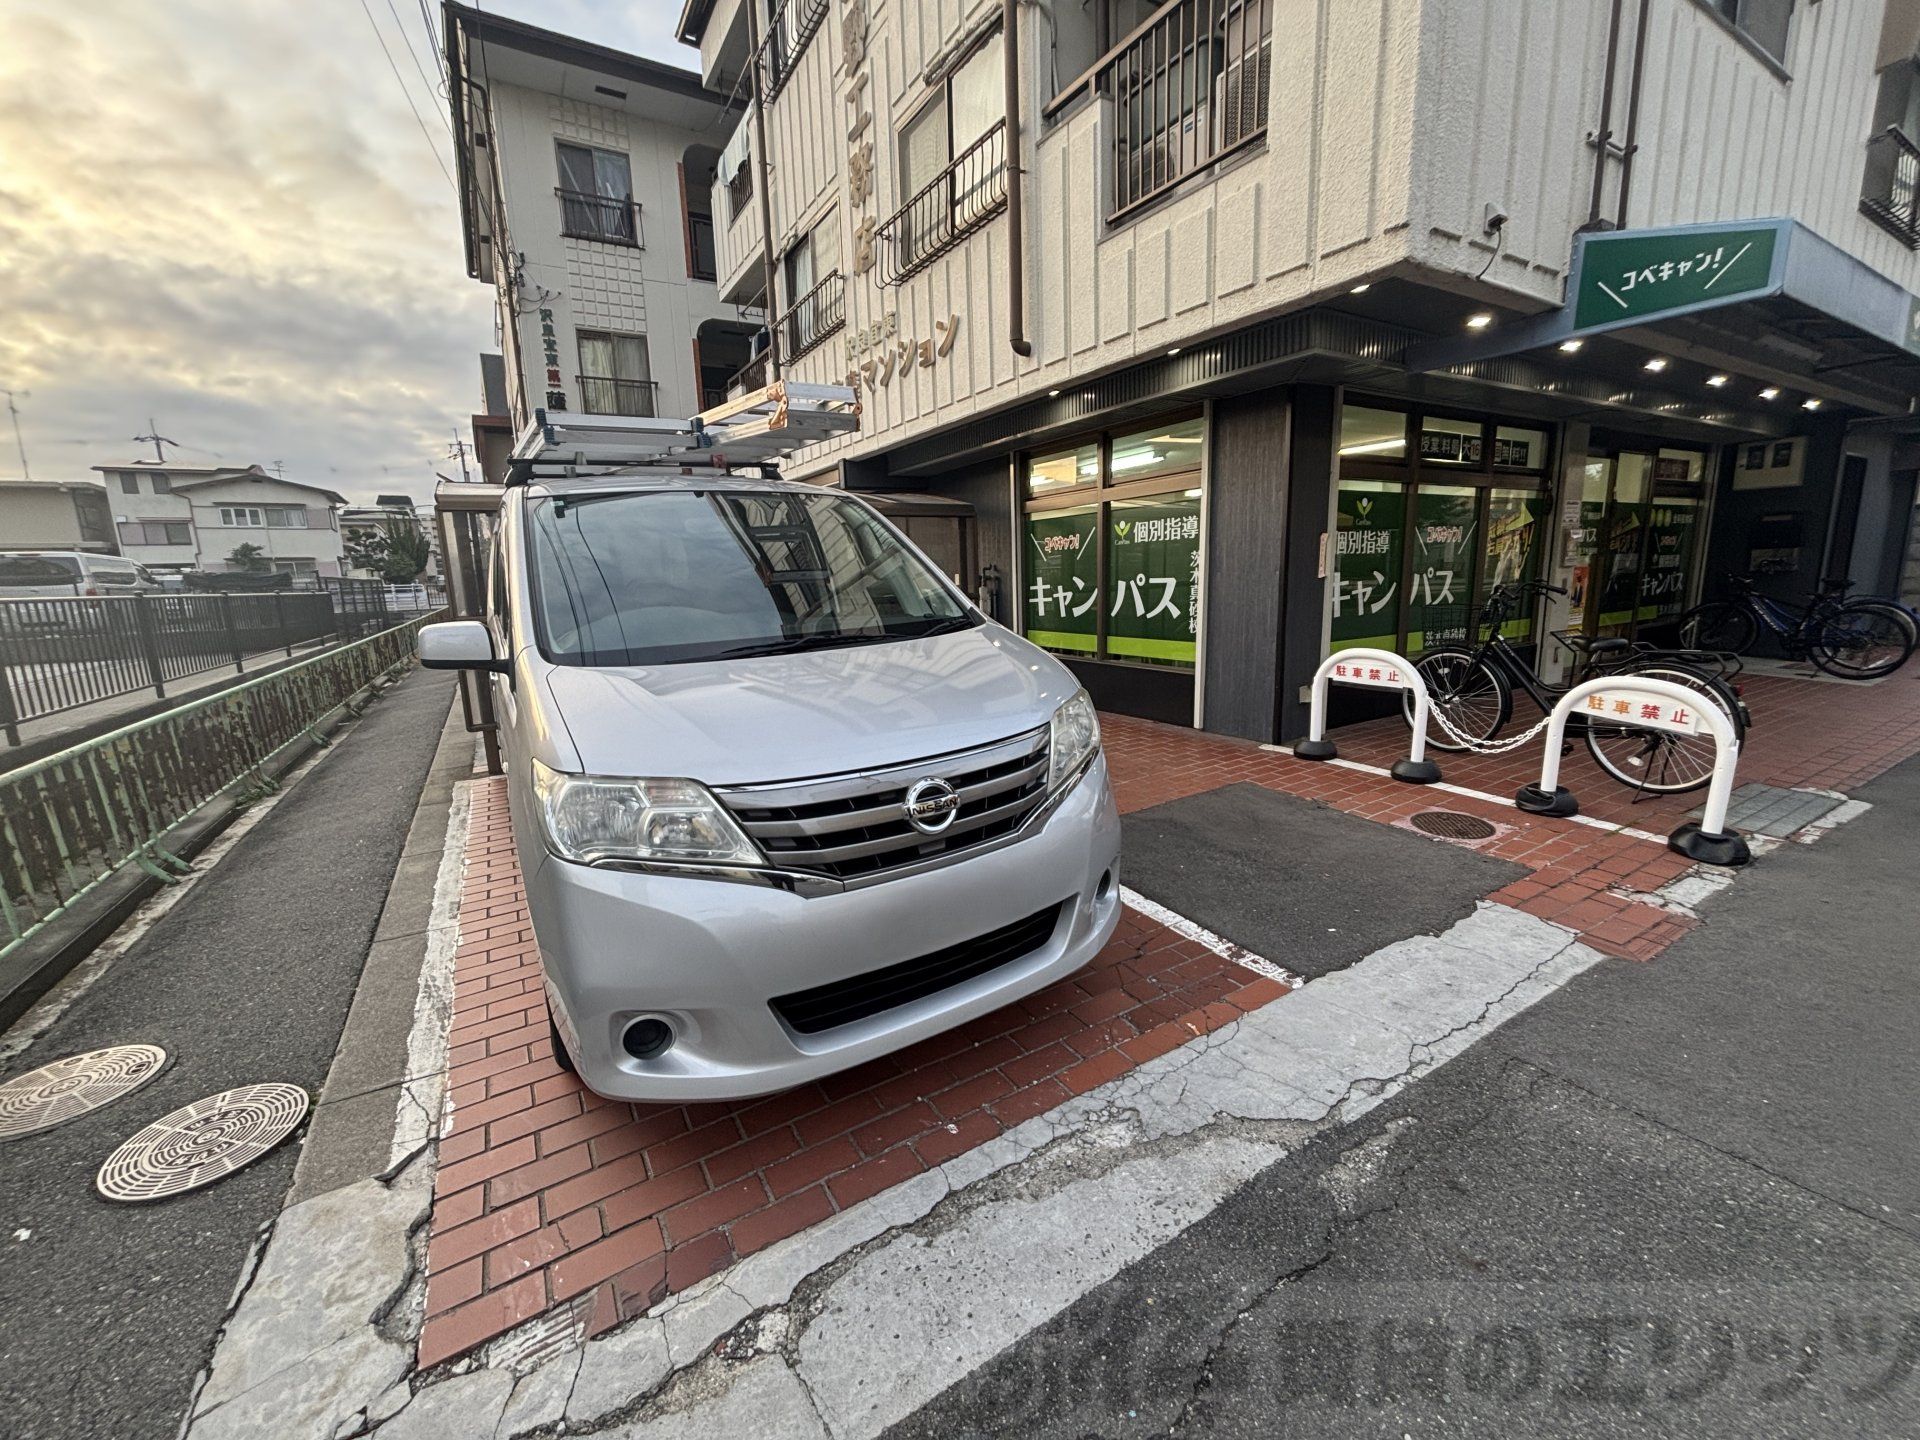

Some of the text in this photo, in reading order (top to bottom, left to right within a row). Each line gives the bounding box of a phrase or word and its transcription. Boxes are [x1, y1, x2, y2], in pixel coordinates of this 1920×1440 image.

[1620, 247, 1724, 292] コベキャン!
[1133, 515, 1199, 543] 個別指導
[1336, 665, 1399, 682] 駐車禁止
[1588, 695, 1689, 725] 駐車禁止
[911, 795, 958, 816] NISSAN
